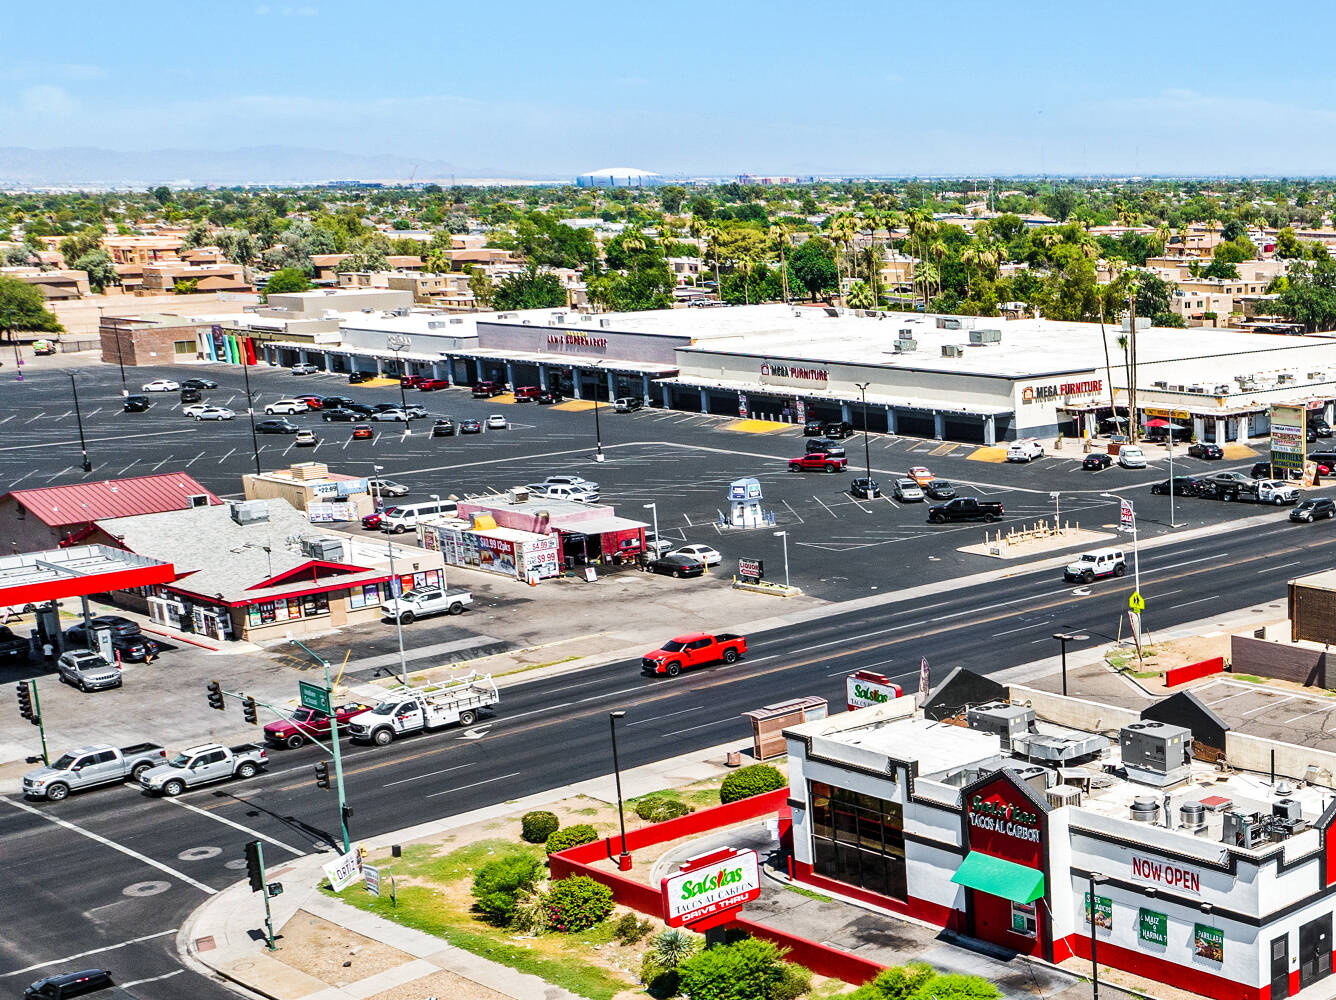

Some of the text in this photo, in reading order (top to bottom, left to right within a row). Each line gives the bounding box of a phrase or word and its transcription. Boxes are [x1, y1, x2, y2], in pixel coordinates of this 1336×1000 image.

[771, 366, 828, 381] MEGA FURNITURE
[1036, 380, 1103, 398] MEGA FURNITURE
[537, 553, 555, 563] $9.99
[969, 812, 1040, 843] TACOS AL CARBON
[1133, 857, 1199, 892] NOW OPEN
[676, 882, 753, 914] TACOS AL CARBON
[682, 893, 749, 921] DRIVE THRU
[1144, 915, 1159, 925] MAIZ
[1142, 929, 1162, 942] HARINA
